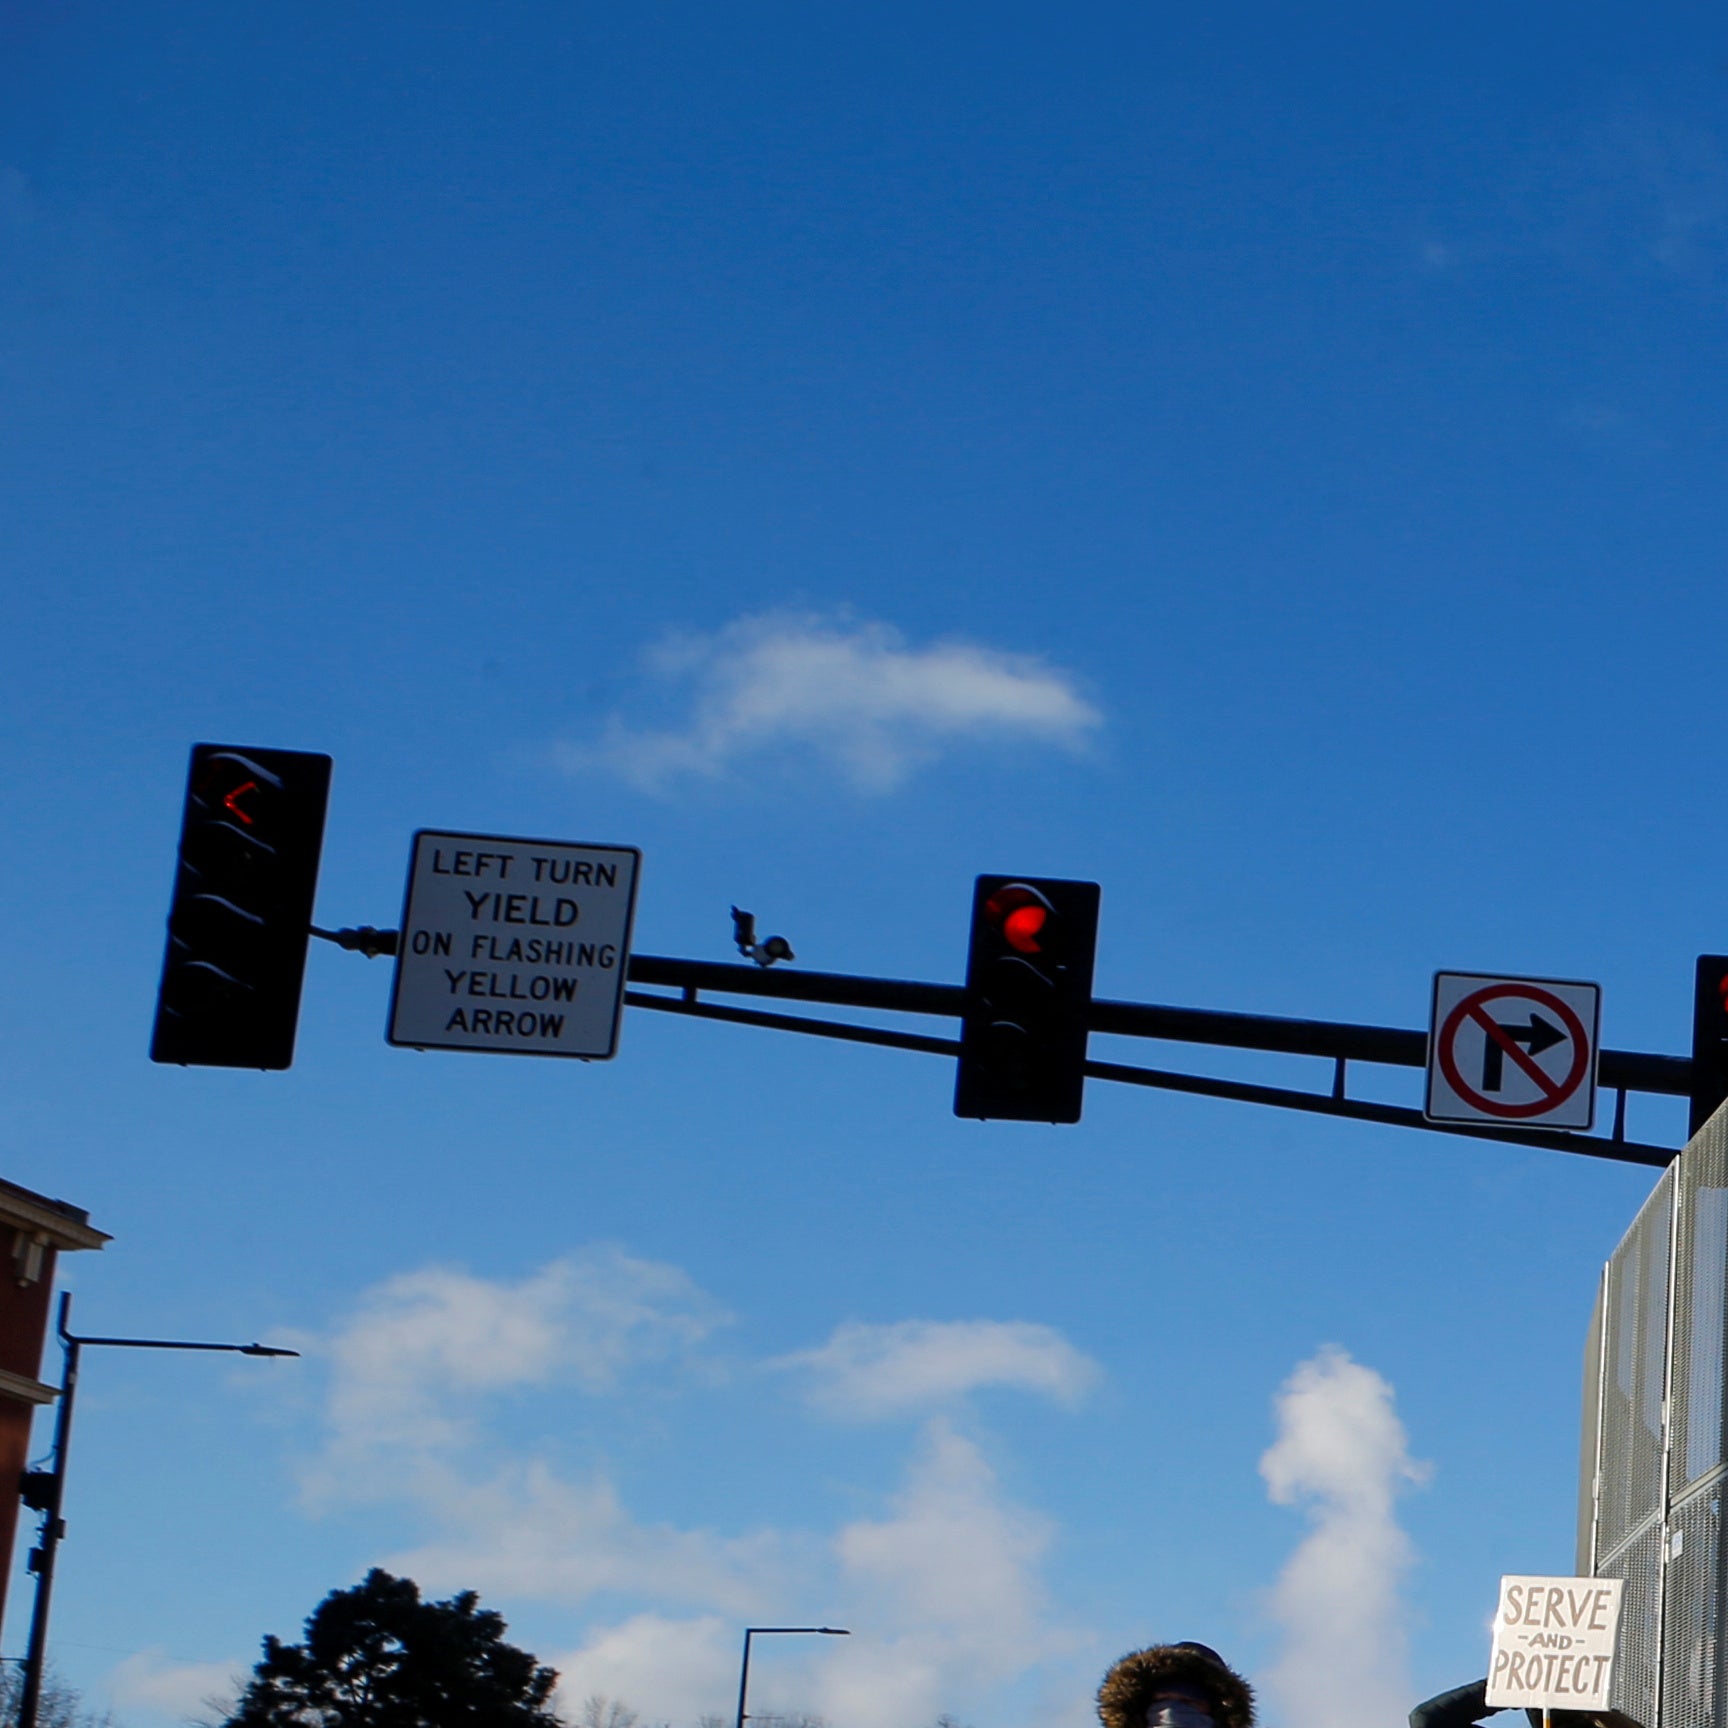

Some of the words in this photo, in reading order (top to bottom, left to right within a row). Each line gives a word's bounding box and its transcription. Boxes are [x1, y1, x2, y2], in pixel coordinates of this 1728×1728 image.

[432, 848, 514, 880] LEFT
[531, 856, 618, 888] TURN
[463, 890, 580, 928] YIELD
[412, 929, 453, 956] ON
[471, 934, 617, 970] FLASHING
[443, 968, 579, 1003] YELLOW
[445, 1006, 565, 1039] ARROW
[1503, 1584, 1612, 1631] SERVE
[1491, 1649, 1612, 1695] PROTECT
